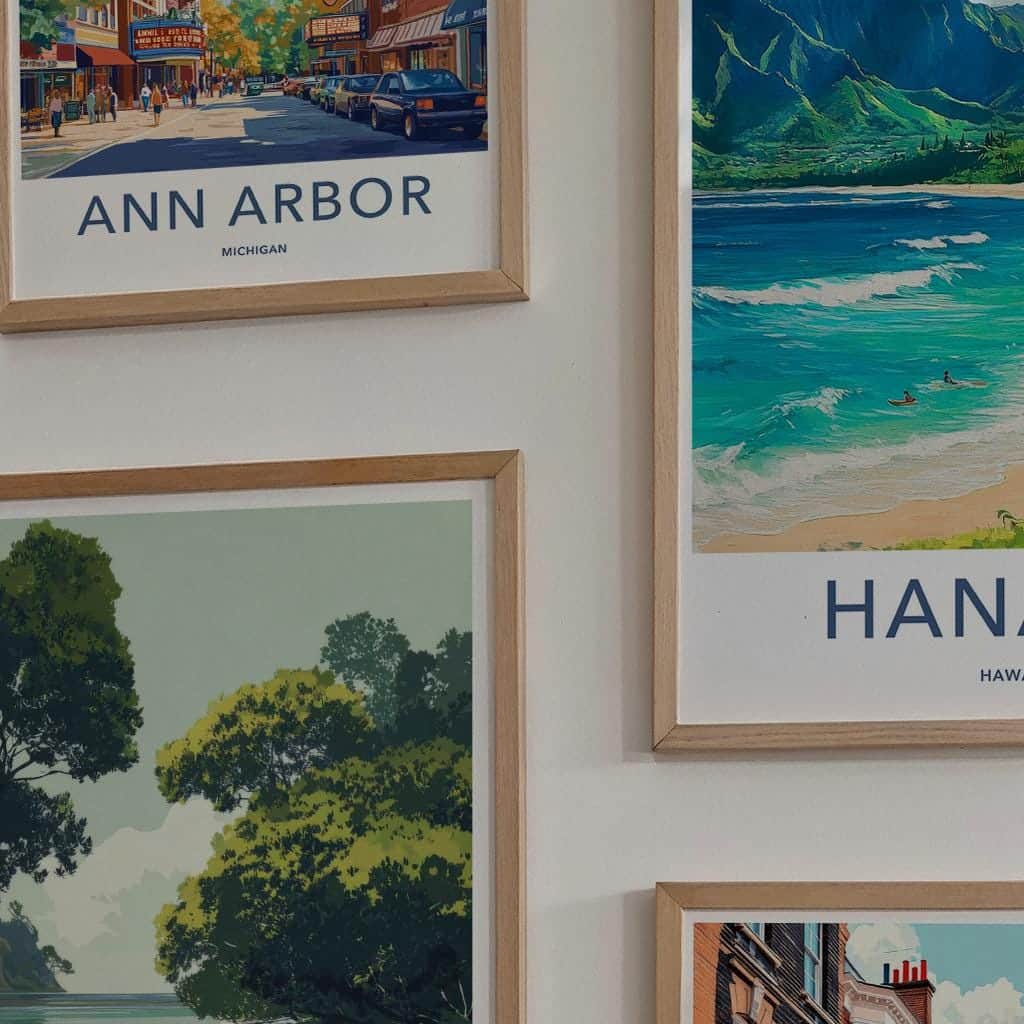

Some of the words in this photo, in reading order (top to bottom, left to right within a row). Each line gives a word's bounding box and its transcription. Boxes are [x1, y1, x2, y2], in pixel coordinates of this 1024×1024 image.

[77, 189, 204, 236] ANN
[228, 175, 432, 226] ARBOR
[221, 243, 288, 257] MICHIGAN
[827, 577, 1024, 639] HAN
[980, 668, 1024, 682] HAW
